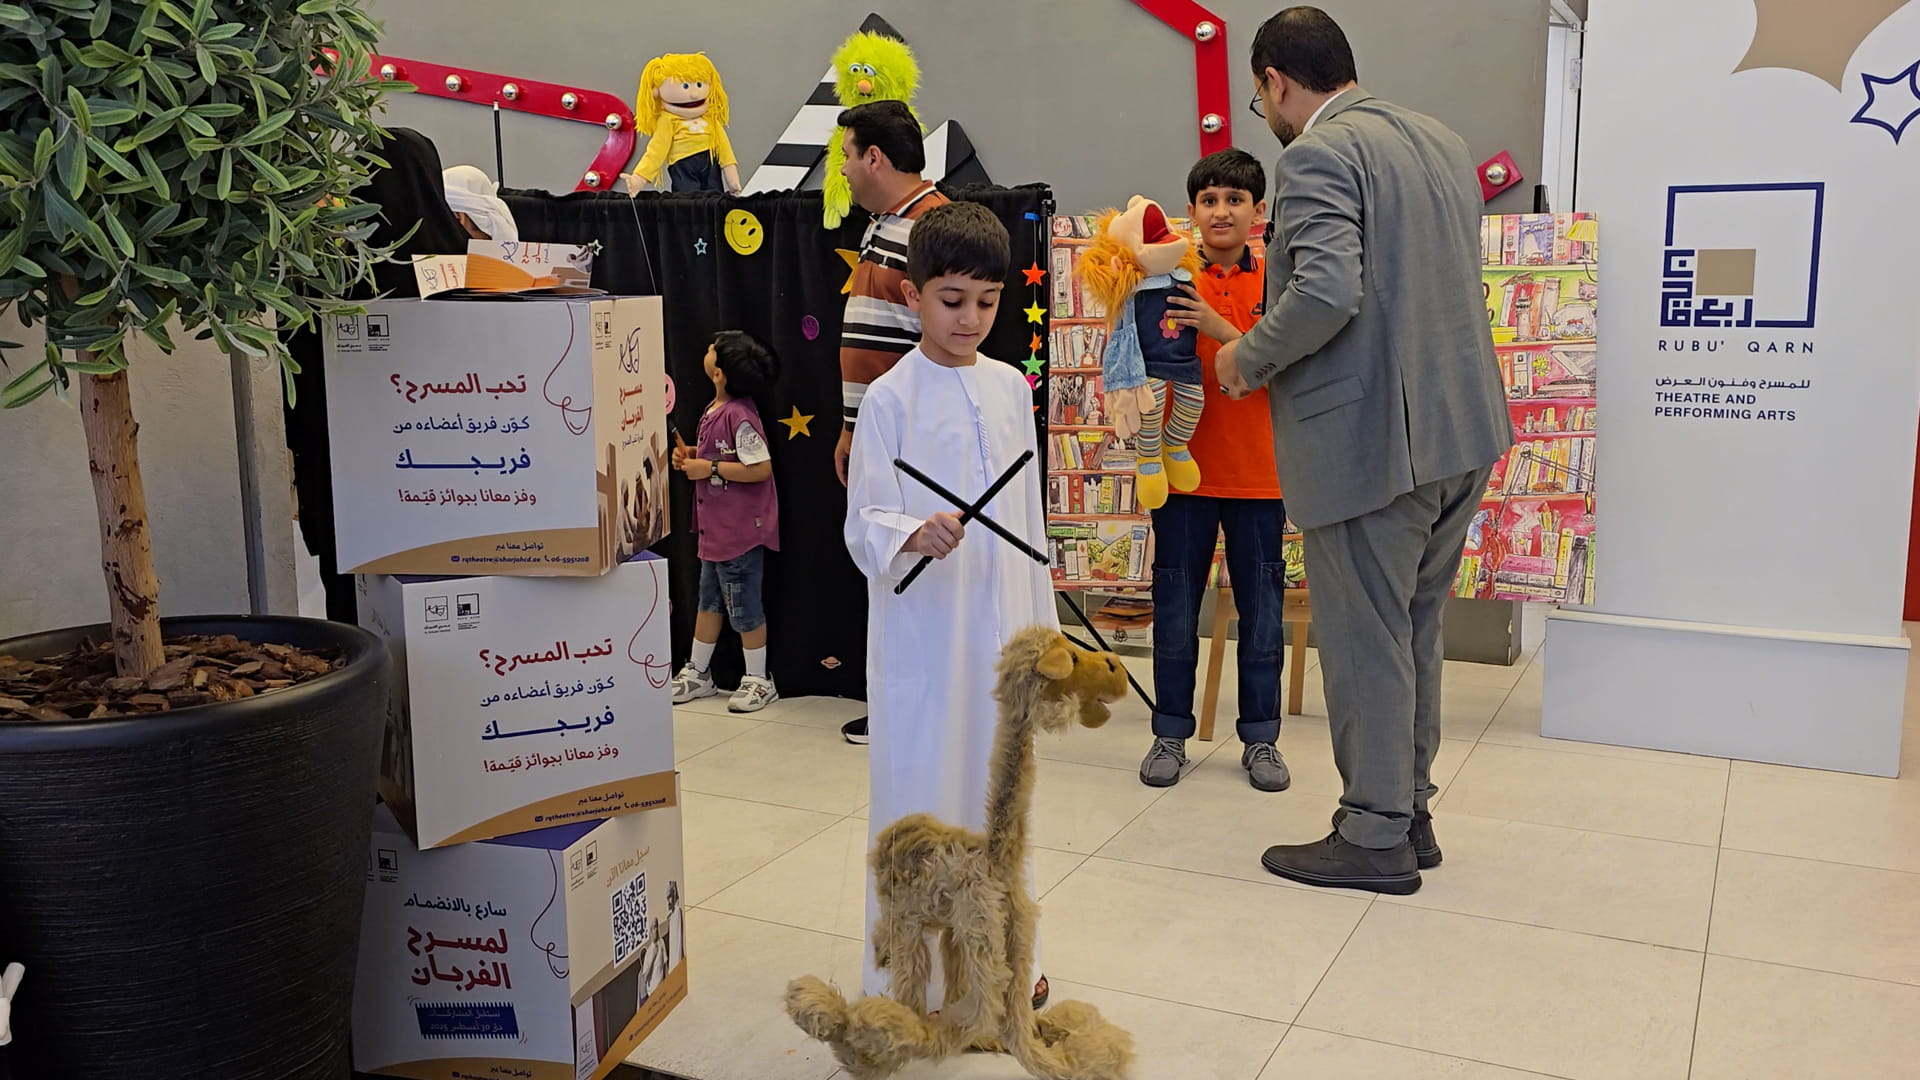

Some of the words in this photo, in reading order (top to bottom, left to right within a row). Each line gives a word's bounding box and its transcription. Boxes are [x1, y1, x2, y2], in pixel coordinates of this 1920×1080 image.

[1658, 339, 1725, 352] RUBU'
[1747, 341, 1814, 354] QARN
[390, 373, 482, 403] المسرح؟
[485, 374, 527, 400] تحب
[1655, 376, 1706, 388] العرض
[1708, 377, 1756, 389] وفنون
[1758, 379, 1811, 390] للمسرح
[1655, 392, 1721, 404] THEATRE
[1725, 394, 1756, 405] AND
[415, 412, 464, 431] أعضاءه
[1654, 406, 1752, 420] PERFORMING
[1756, 410, 1796, 421] ARTS
[393, 421, 413, 433] من
[465, 416, 498, 433] فريق
[440, 488, 477, 506] بجوائز
[479, 488, 511, 502] معانا
[514, 488, 537, 505] وفز
[506, 541, 521, 550] معنا
[521, 541, 544, 551] تواصل
[479, 641, 570, 676] المسرح؟
[573, 638, 613, 664] تحب
[503, 681, 551, 701] أعضاءه
[553, 680, 584, 698] فريق
[480, 693, 500, 707] من
[564, 748, 595, 762] معانا
[597, 744, 619, 760] وفز
[525, 753, 562, 770] بجوائز
[588, 794, 602, 803] معنا
[603, 791, 625, 802] تواصل
[403, 893, 472, 917] بالانضمام
[475, 899, 507, 920] سارع
[406, 926, 508, 957] لمسرح
